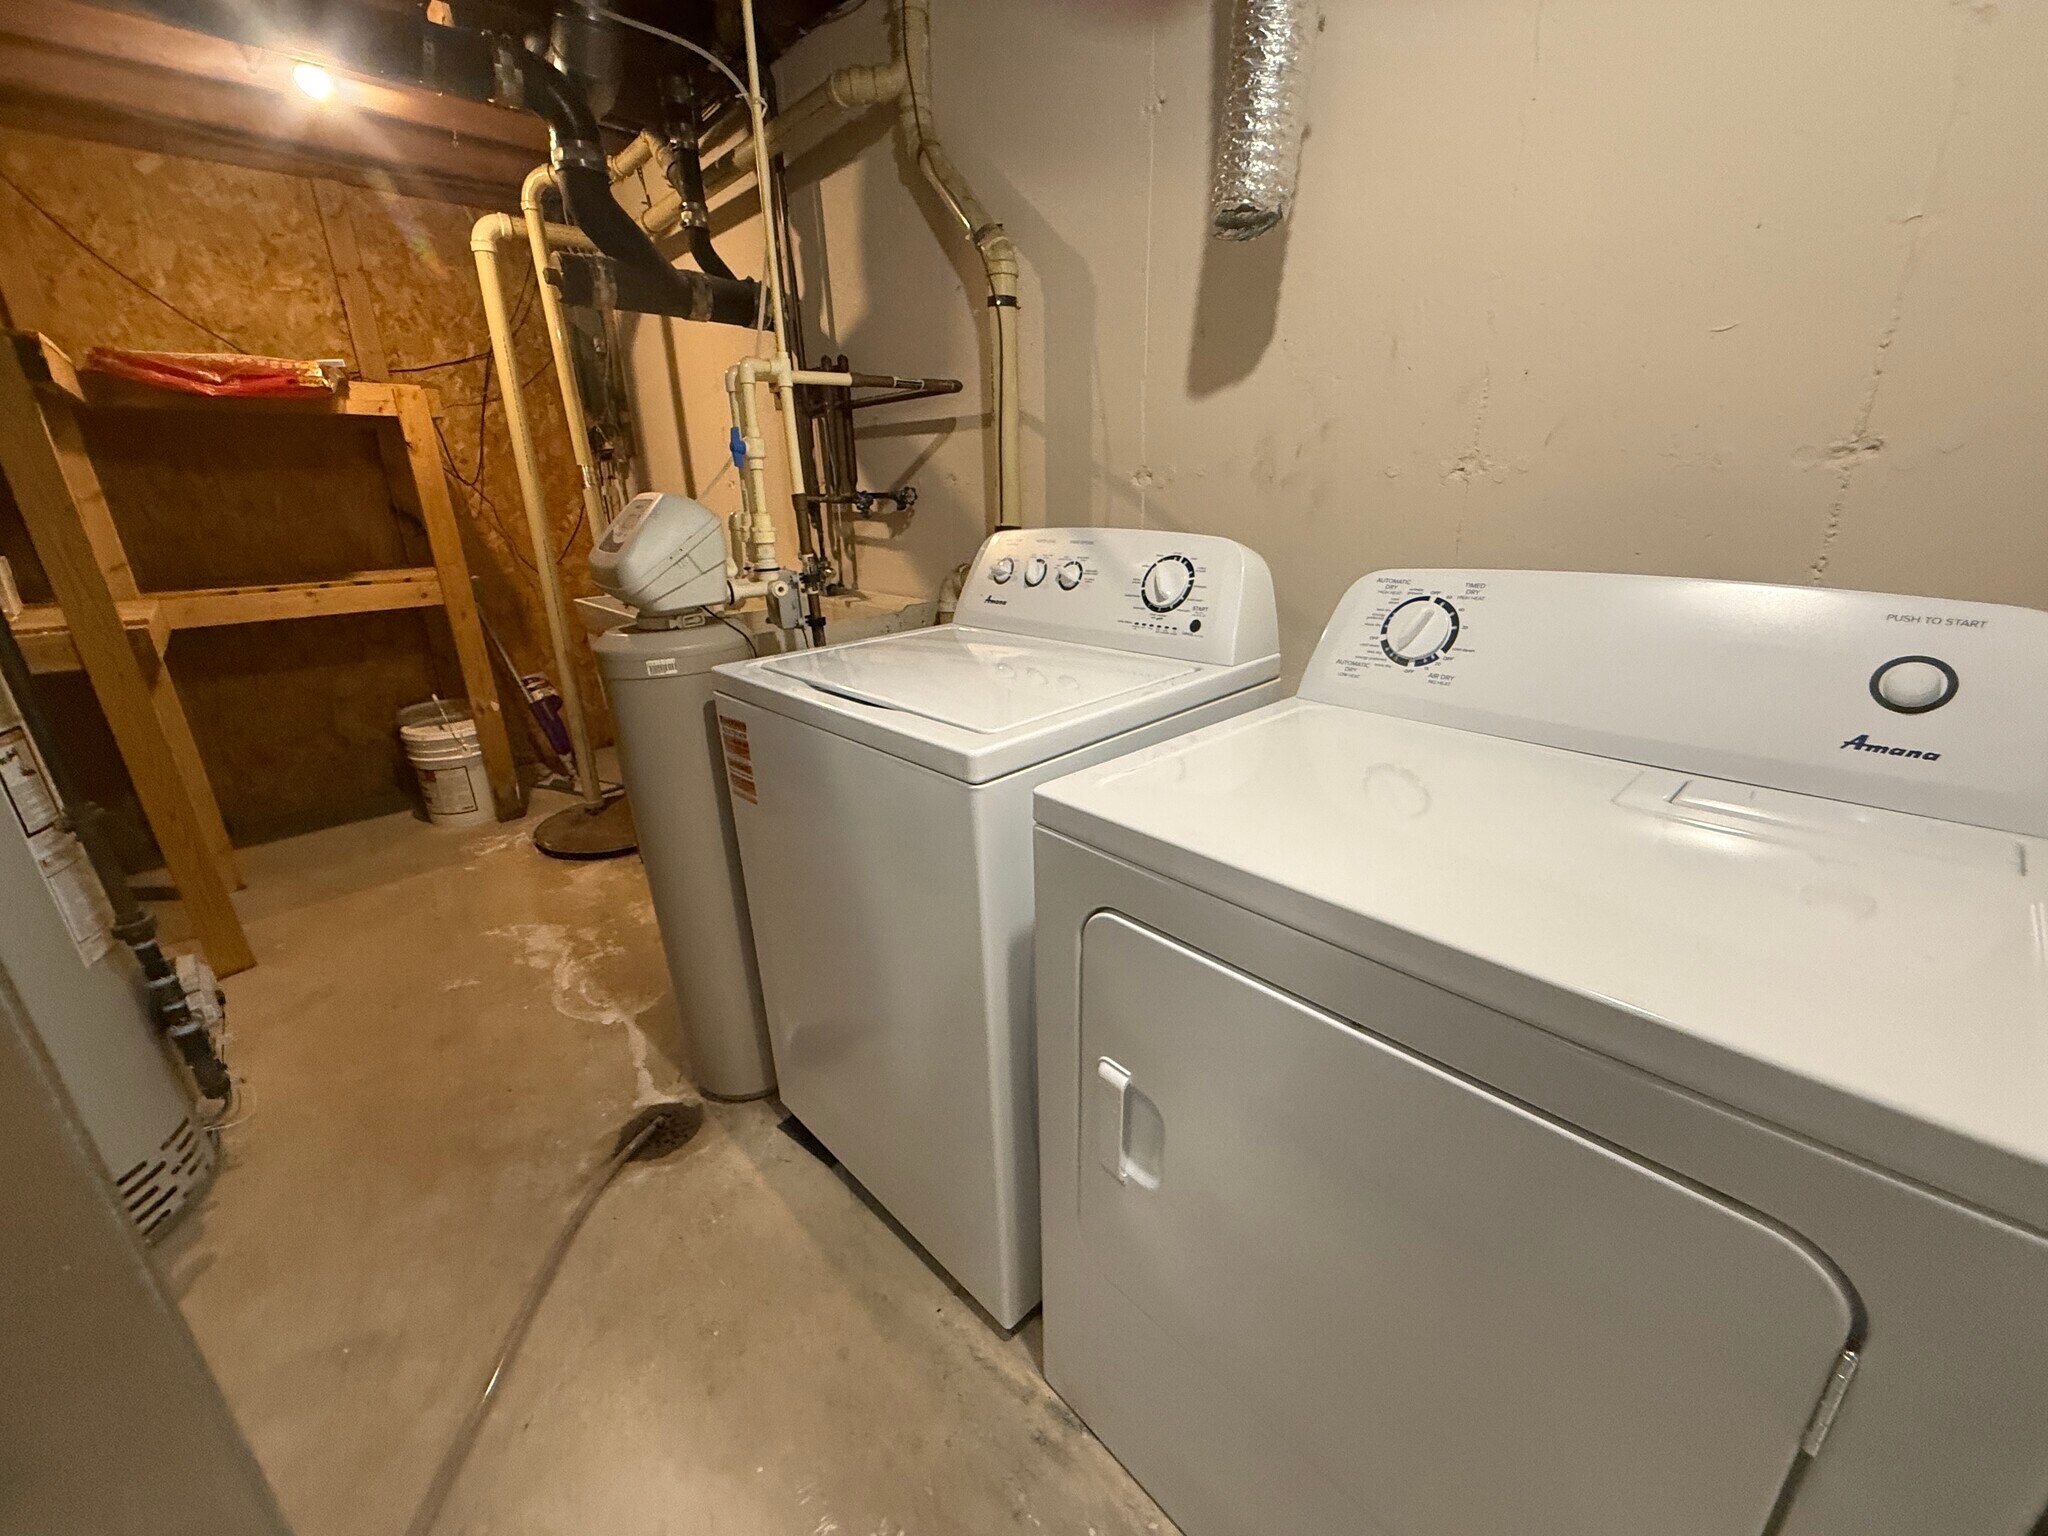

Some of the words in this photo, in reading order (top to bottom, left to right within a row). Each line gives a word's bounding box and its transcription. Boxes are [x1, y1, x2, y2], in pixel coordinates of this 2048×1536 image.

[1886, 613, 1921, 623] PUSH
[1926, 616, 1942, 625] TO
[1945, 618, 1988, 628] START
[1840, 734, 1941, 762] Amana
